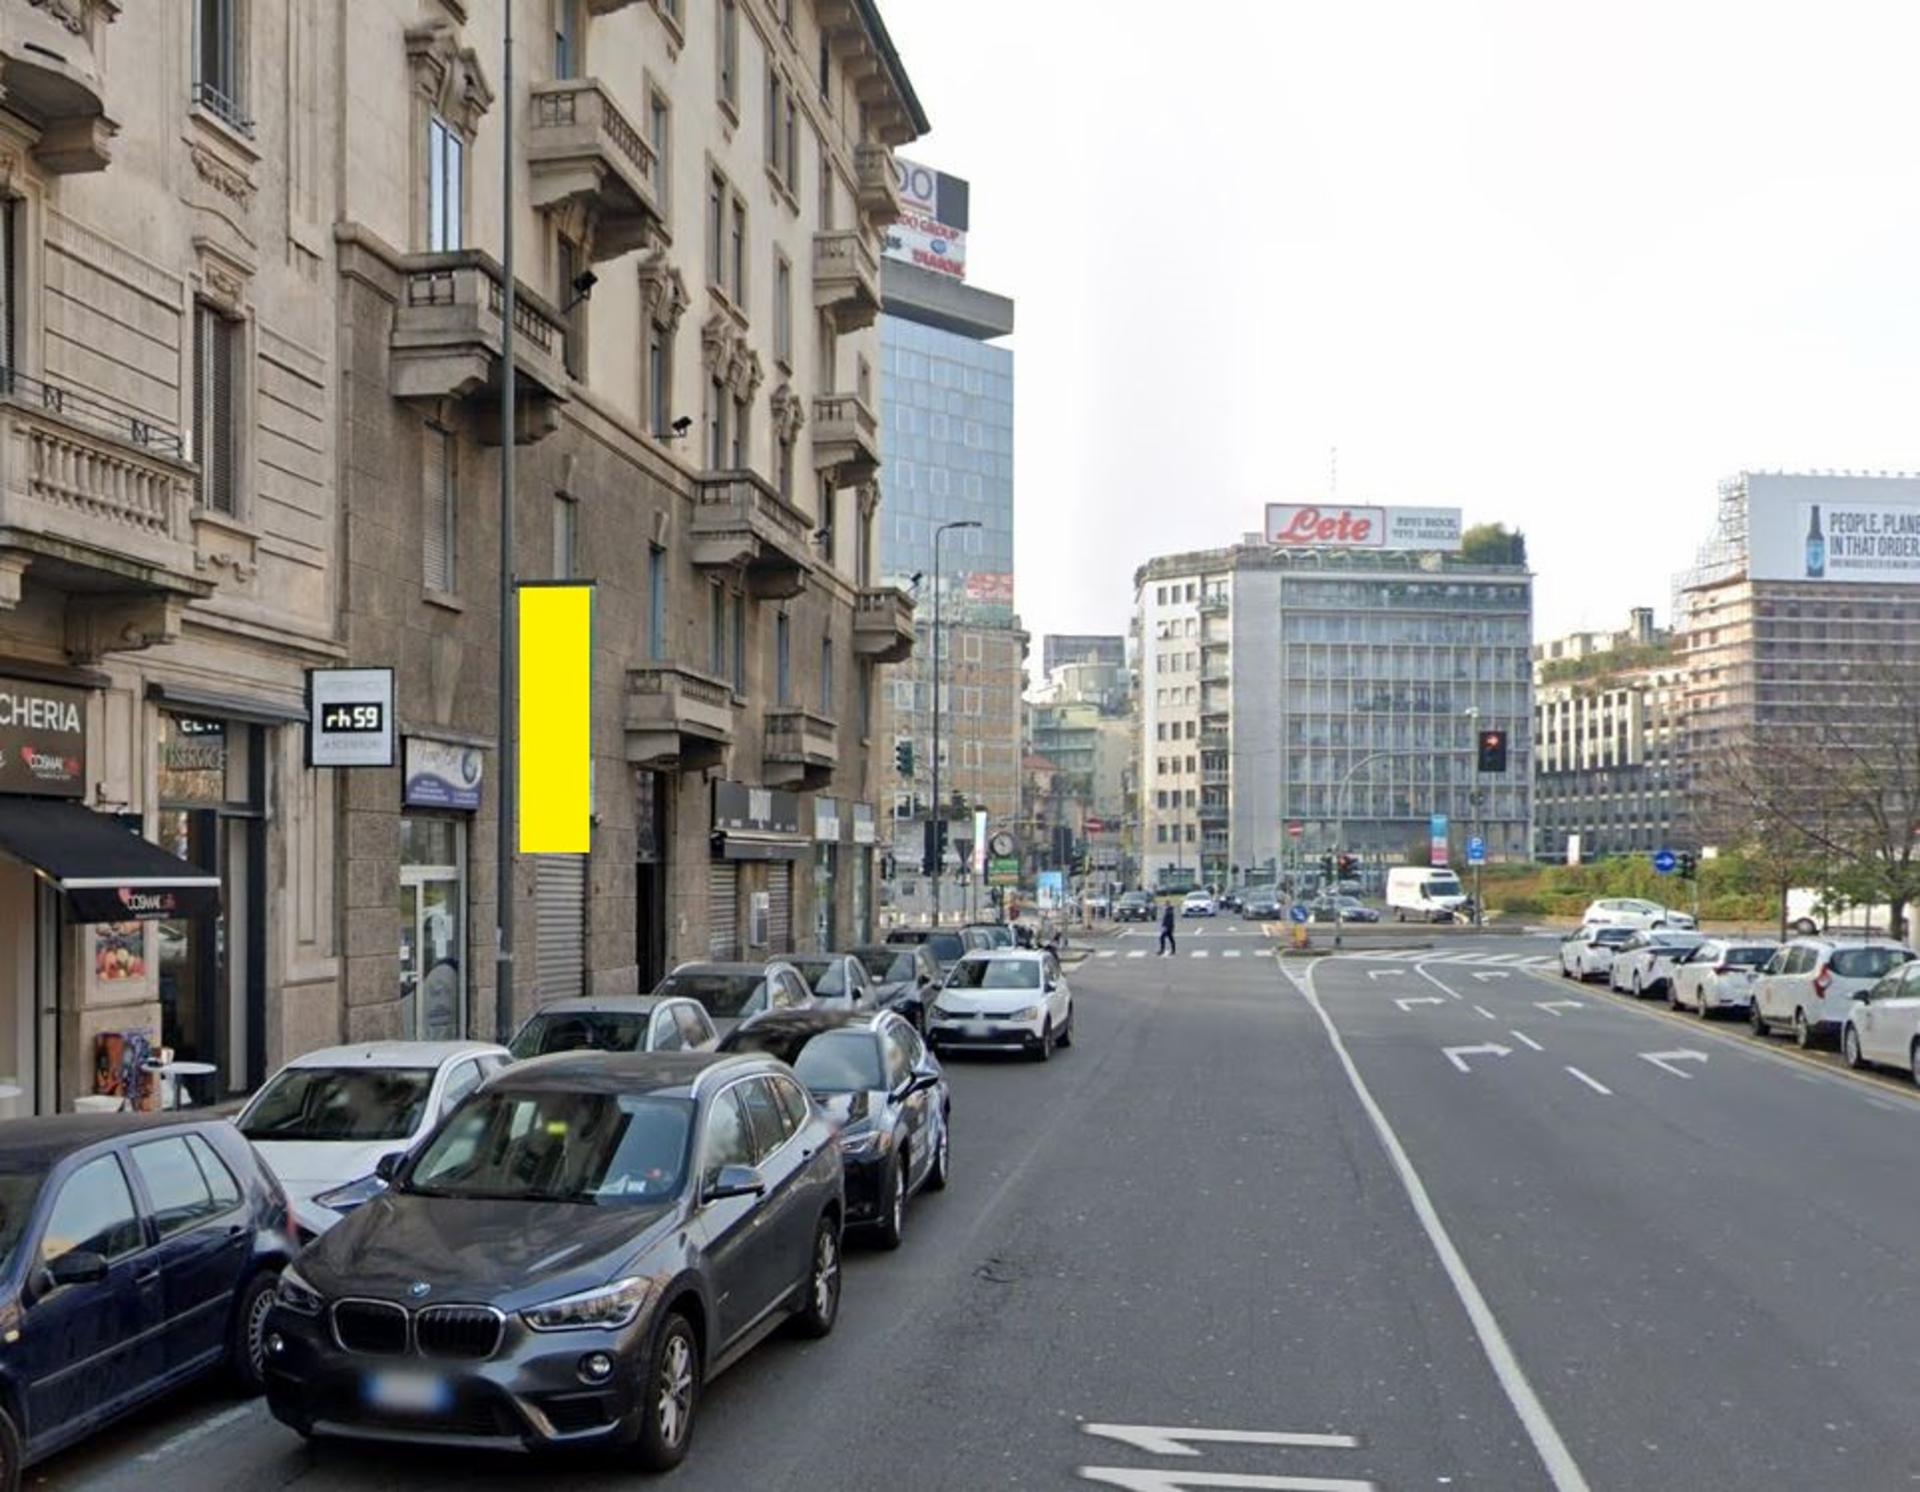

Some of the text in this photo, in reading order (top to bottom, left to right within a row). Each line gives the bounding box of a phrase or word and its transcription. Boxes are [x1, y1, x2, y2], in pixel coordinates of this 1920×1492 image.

[1277, 507, 1371, 544] Lete
[1830, 535, 1844, 556] IN
[1846, 535, 1875, 556] THAT
